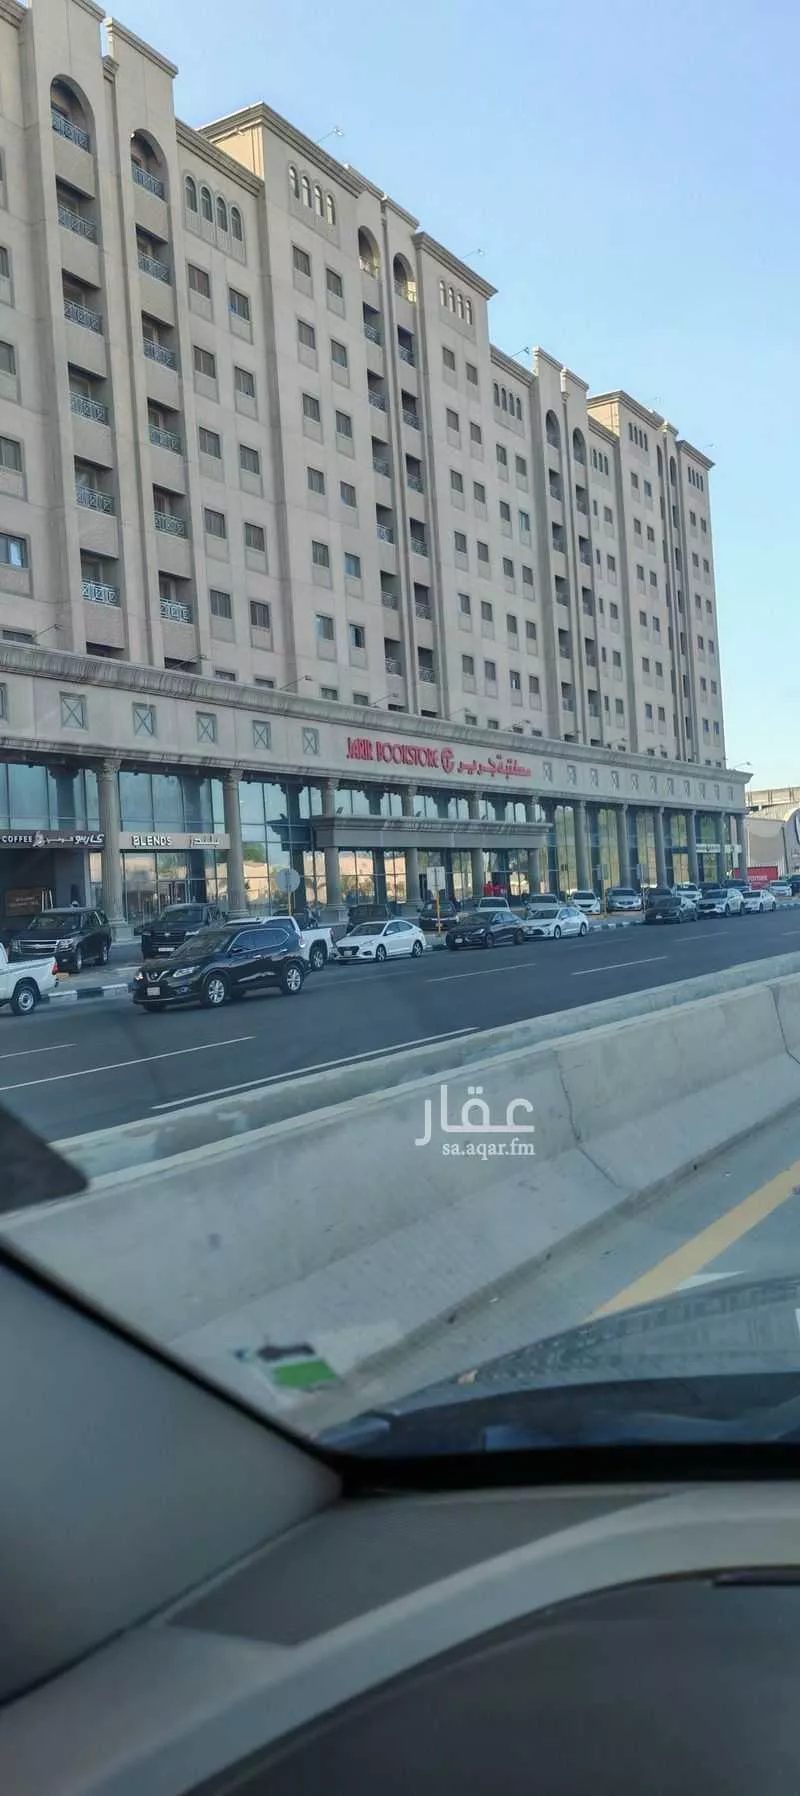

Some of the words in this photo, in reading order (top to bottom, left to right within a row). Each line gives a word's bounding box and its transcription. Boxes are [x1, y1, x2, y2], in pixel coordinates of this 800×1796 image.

[375, 740, 440, 768] BOOKSTORE
[1, 835, 33, 843] COFFEE
[132, 835, 173, 847] BLENDS
